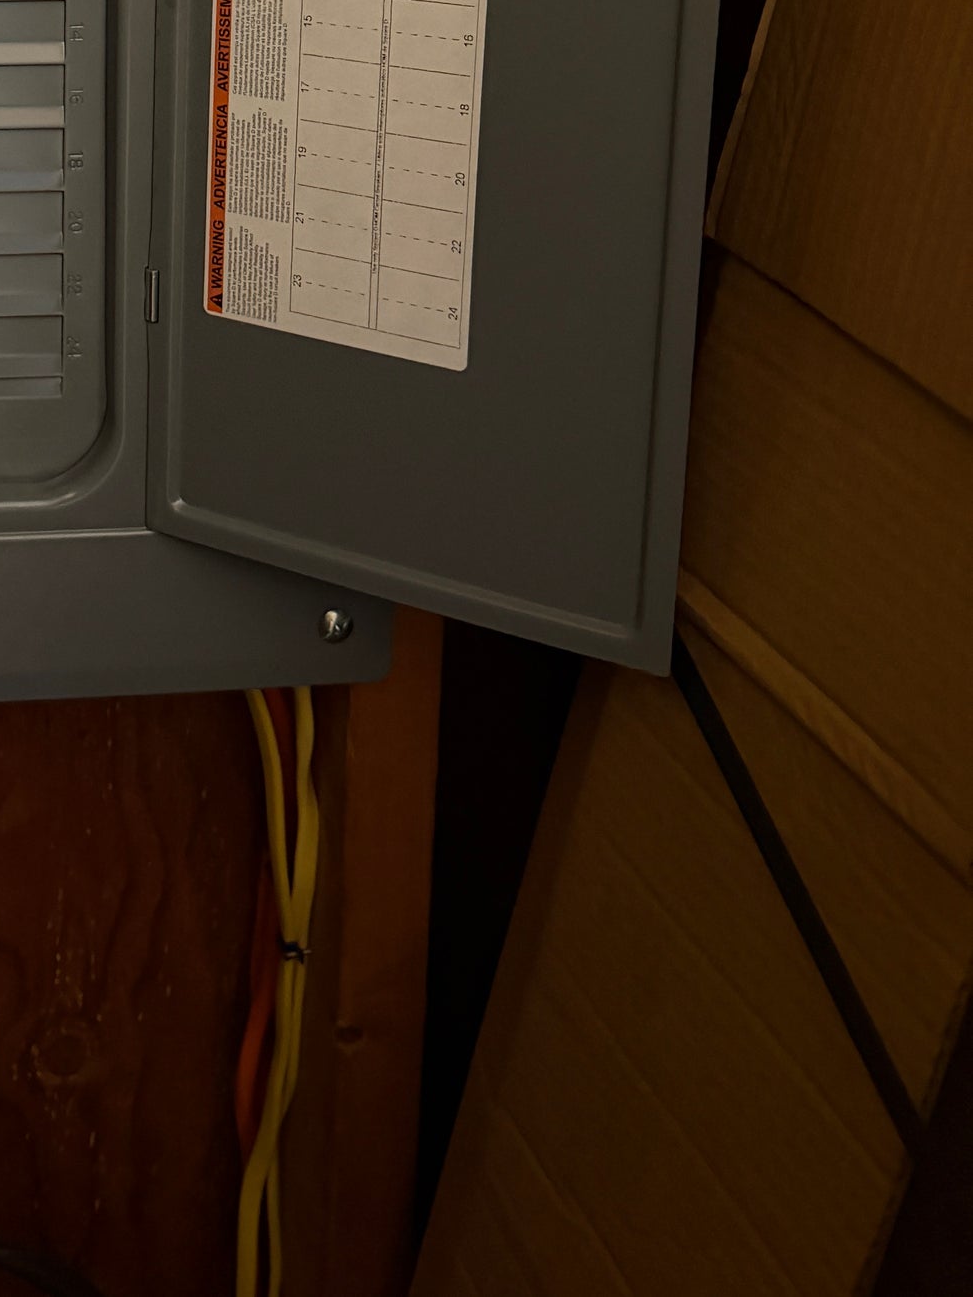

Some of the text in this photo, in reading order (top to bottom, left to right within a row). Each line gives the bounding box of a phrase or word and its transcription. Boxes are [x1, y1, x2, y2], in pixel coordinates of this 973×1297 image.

[303, 15, 312, 27] 15
[70, 23, 85, 42] 14
[464, 34, 474, 47] 16
[300, 81, 309, 93] 17
[69, 89, 85, 104] 16
[459, 104, 469, 117] 18
[213, 104, 228, 210] ADVERTENCIA
[298, 146, 307, 158] 19
[69, 151, 84, 170] 18
[455, 172, 465, 187] 20
[295, 211, 304, 224] 21
[210, 219, 224, 289] WARNING
[451, 240, 461, 254] 22
[292, 274, 301, 288] 23
[448, 307, 458, 321] 24
